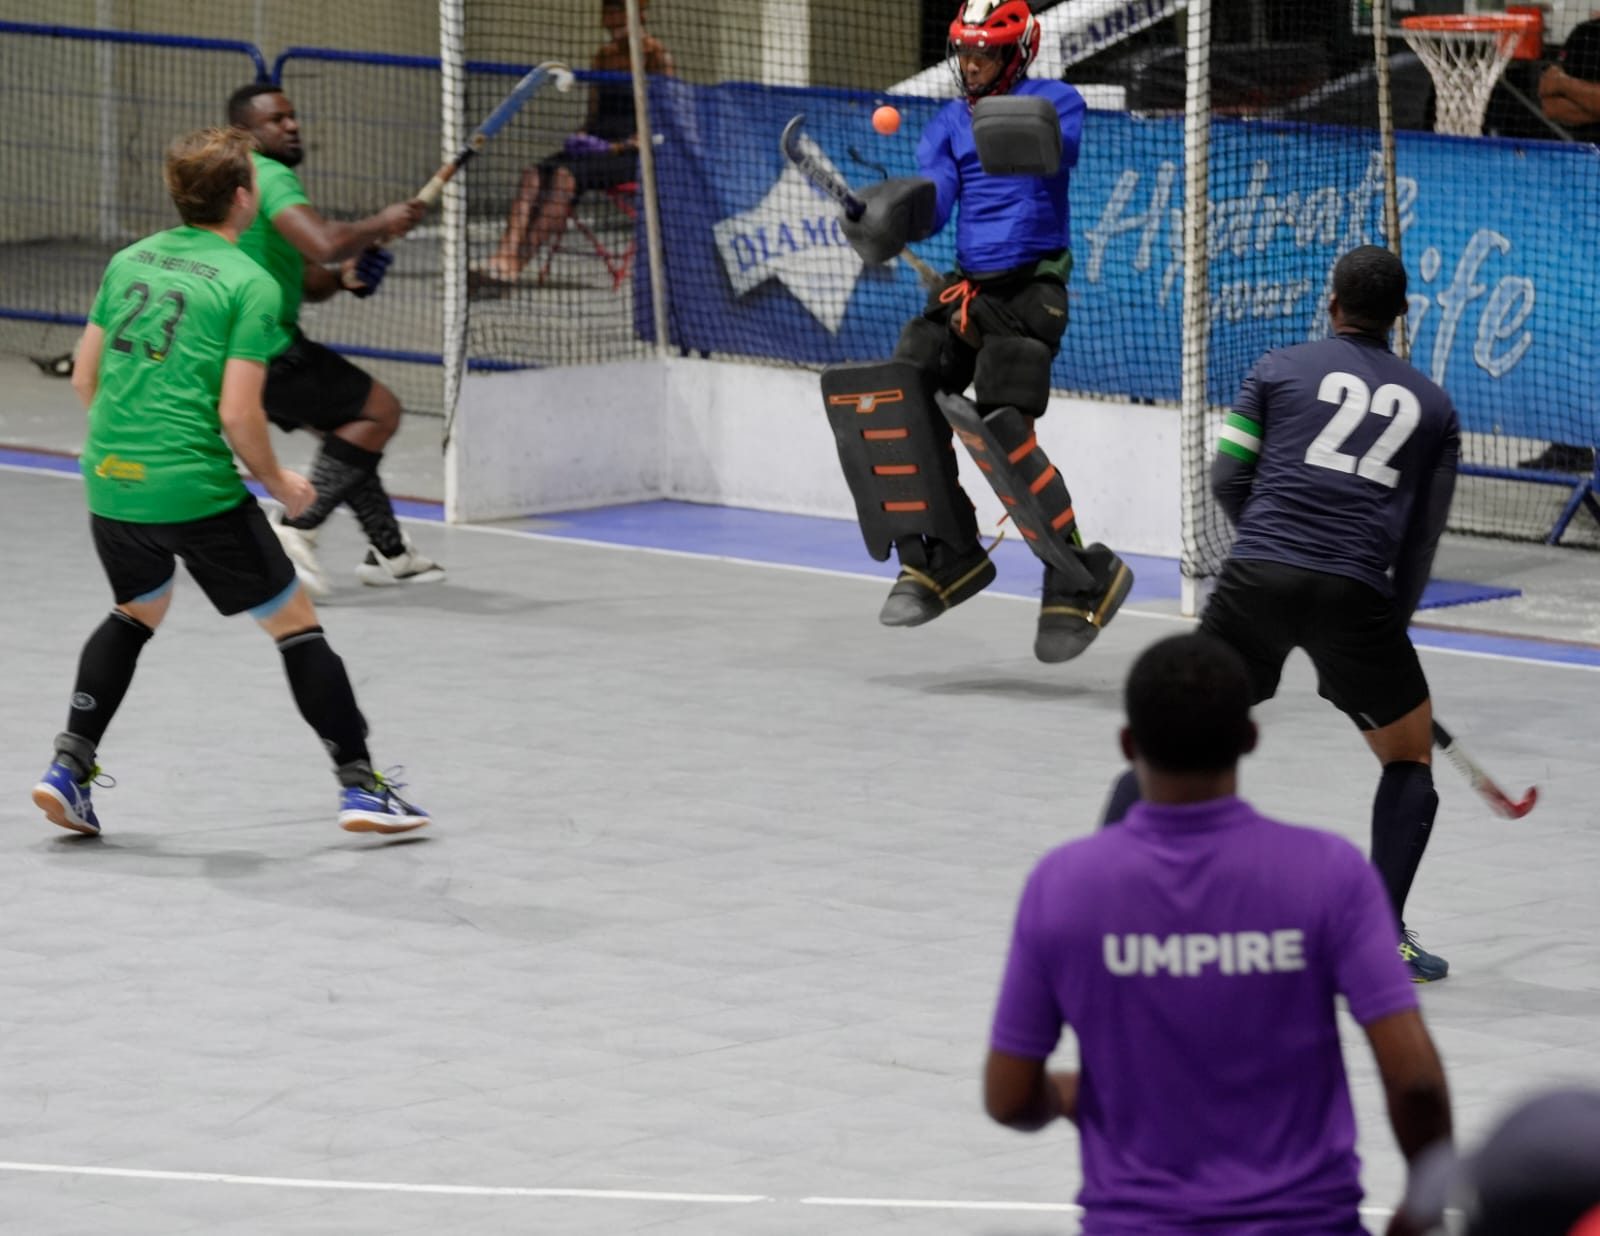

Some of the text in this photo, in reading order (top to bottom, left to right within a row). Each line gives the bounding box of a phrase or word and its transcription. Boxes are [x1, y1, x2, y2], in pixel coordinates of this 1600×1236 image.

[111, 281, 185, 363] 23
[1304, 371, 1422, 489] 22
[1103, 928, 1306, 977] UMPIRE
